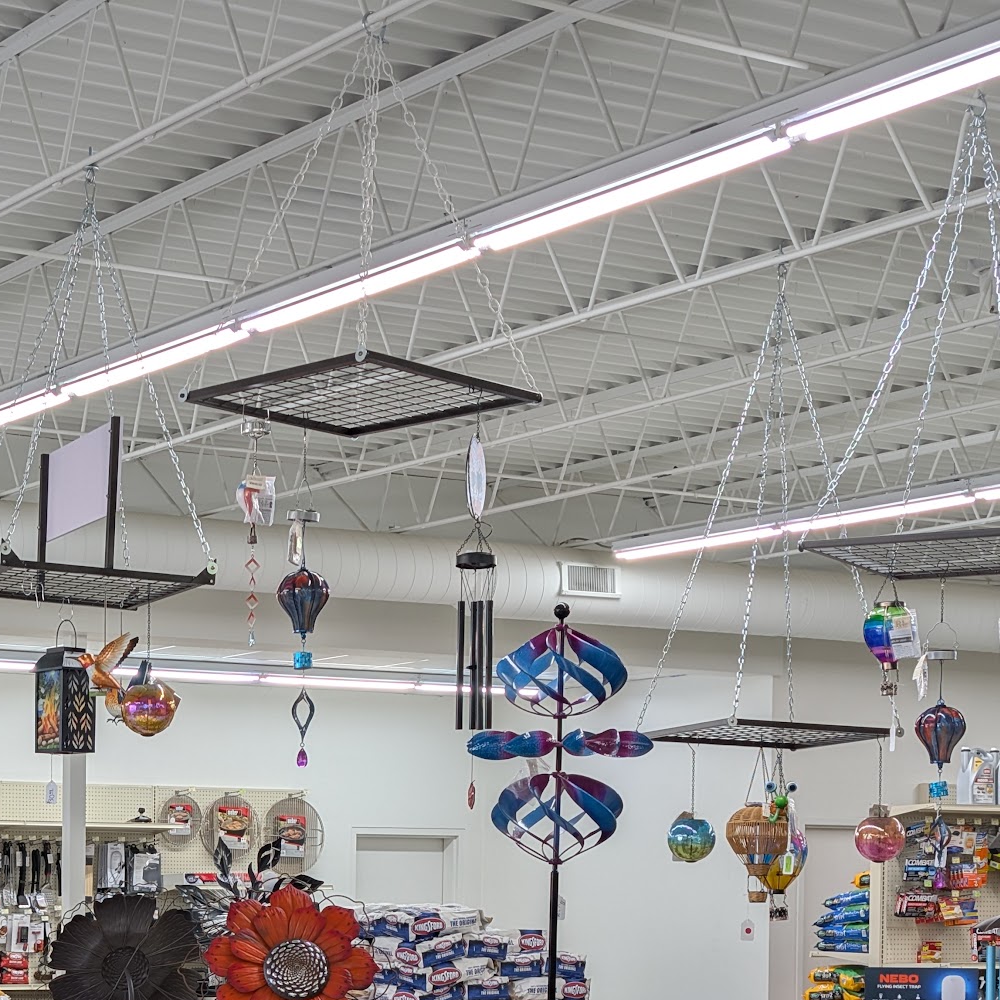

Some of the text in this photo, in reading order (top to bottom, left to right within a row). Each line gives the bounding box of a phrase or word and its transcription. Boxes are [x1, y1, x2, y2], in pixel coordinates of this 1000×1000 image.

[414, 921, 443, 932] KINGSFORD
[521, 937, 545, 948] KINGSFORD
[432, 971, 460, 982] KINGSFORD
[879, 973, 919, 984] NEBO
[564, 985, 586, 996] KINGSFORD
